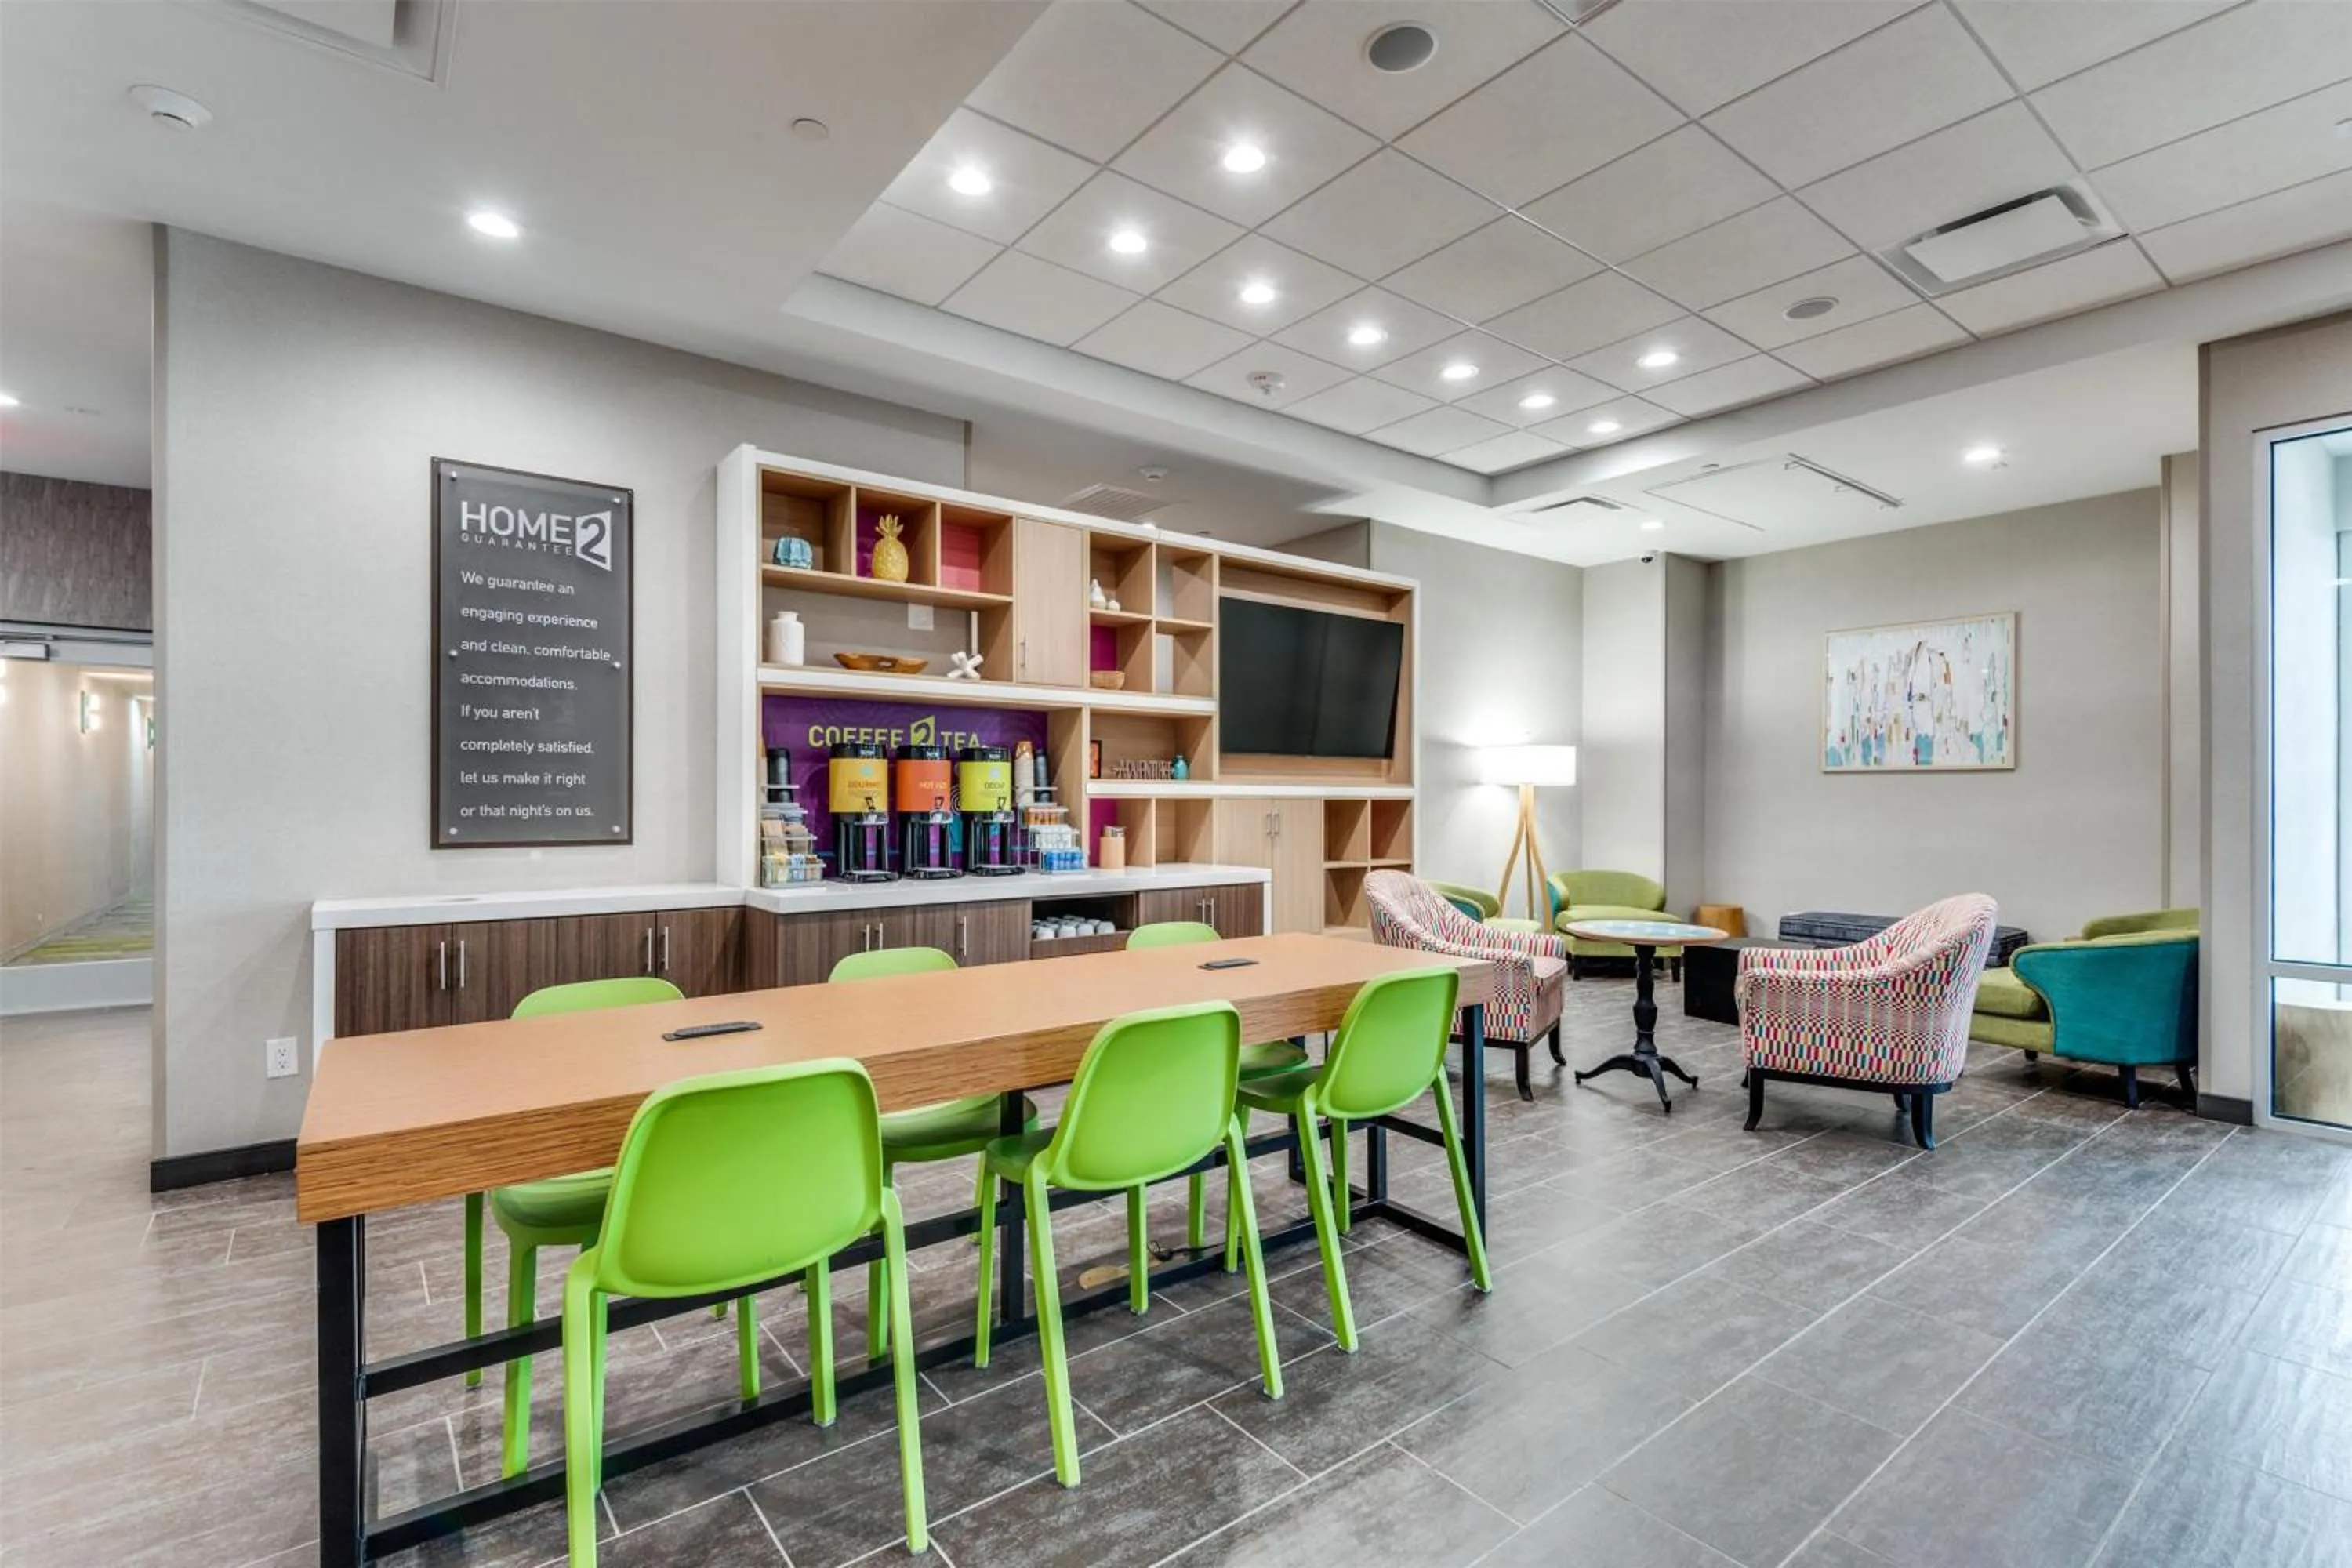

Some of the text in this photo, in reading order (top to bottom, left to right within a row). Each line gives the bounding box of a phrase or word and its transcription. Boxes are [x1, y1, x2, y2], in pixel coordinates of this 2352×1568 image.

[461, 501, 572, 544] HOME
[461, 532, 572, 556] GUARANTEE
[461, 571, 575, 594] We guarantee an
[461, 607, 598, 628] engaging experience
[461, 640, 487, 652] and
[534, 646, 610, 661] comfortable
[460, 674, 577, 690] accommodations.
[461, 704, 540, 720] If you aren't
[460, 739, 533, 754] completely
[808, 725, 904, 749] COFFEE
[941, 731, 980, 751] TEA
[460, 771, 586, 788] let us make it right
[460, 804, 594, 819] or that night's on us.
